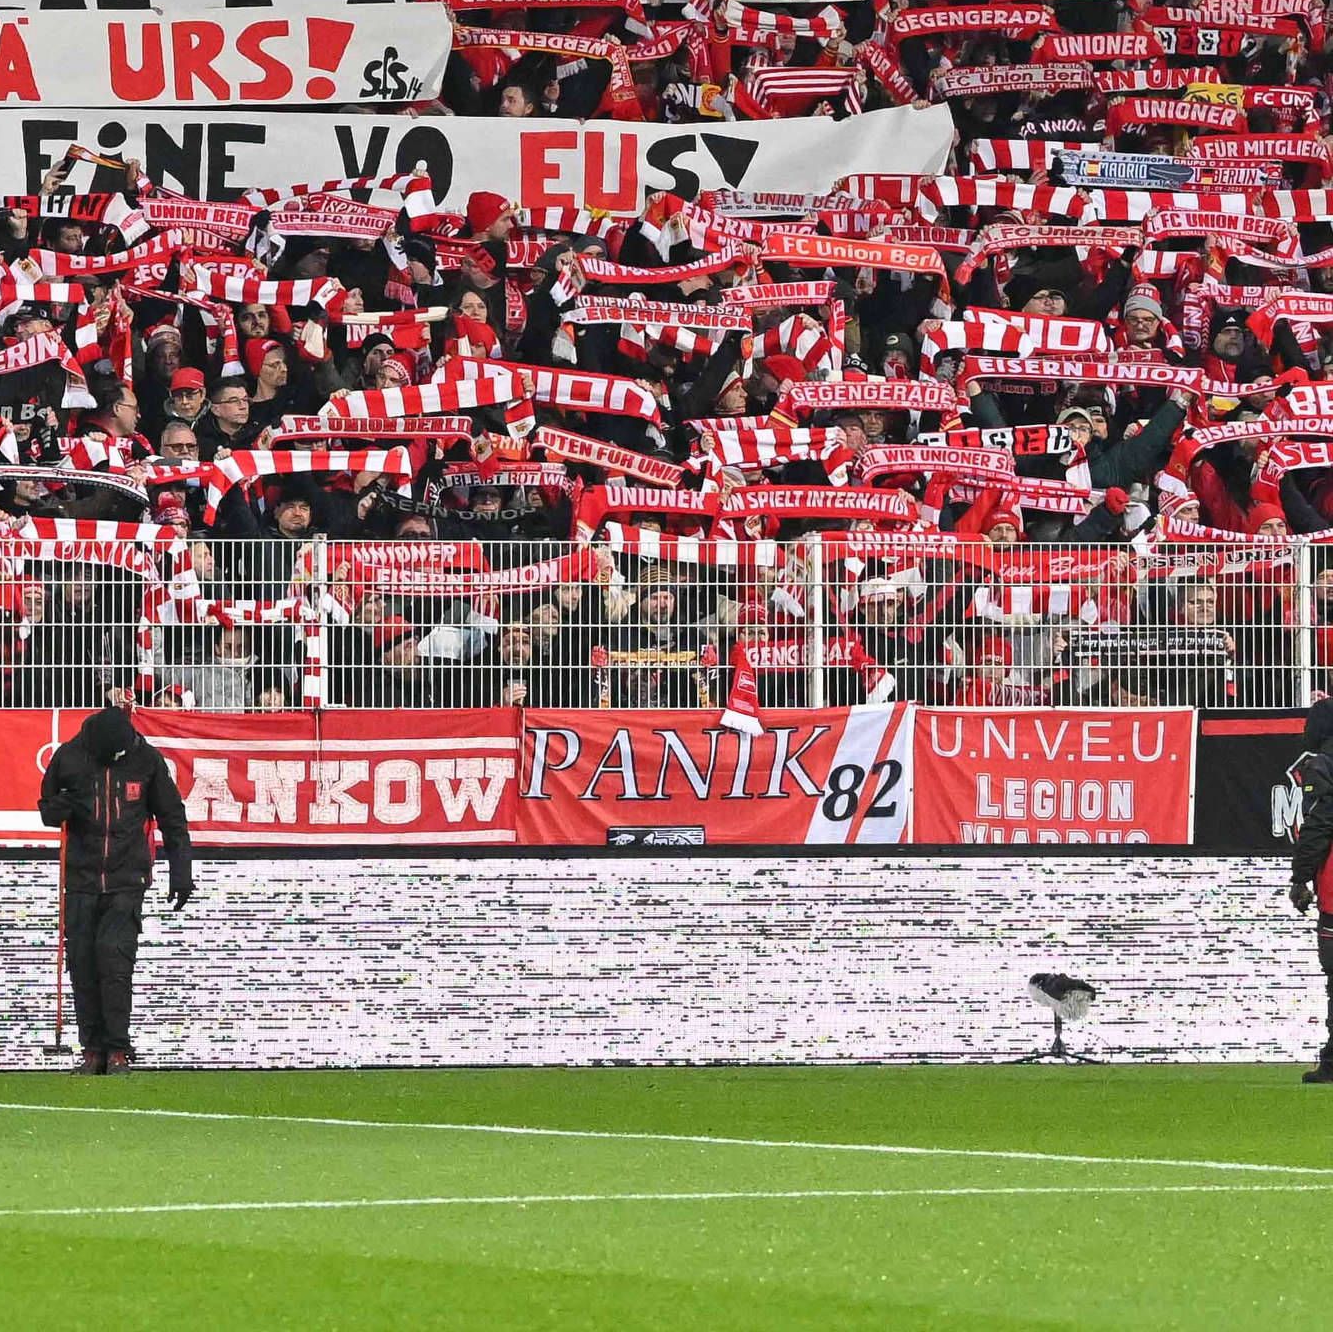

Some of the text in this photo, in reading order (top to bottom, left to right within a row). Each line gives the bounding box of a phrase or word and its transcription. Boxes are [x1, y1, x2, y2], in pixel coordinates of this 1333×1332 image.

[895, 8, 1050, 31] GEGENGERADE
[107, 18, 354, 97] URS!
[1054, 36, 1148, 56] UNIONER
[945, 70, 1050, 91] FC Union
[1134, 98, 1236, 127] UNIONER
[1203, 139, 1239, 158] FÜR
[1098, 162, 1148, 179] MADRID
[1212, 169, 1259, 185] BERLIN
[148, 204, 207, 221] UNION
[782, 237, 880, 261] FC Union
[979, 359, 1198, 384] EISERN UNION
[792, 385, 951, 405] GEGENGERADE
[884, 449, 997, 468] WIR UNIONER
[606, 484, 705, 509] UNIONER
[748, 490, 805, 510] SPIELT
[930, 715, 1178, 764] U.N.V.E.U.
[523, 725, 903, 822] PANIK 82
[167, 758, 516, 825] ANKOW
[976, 771, 1134, 821] LEGION
